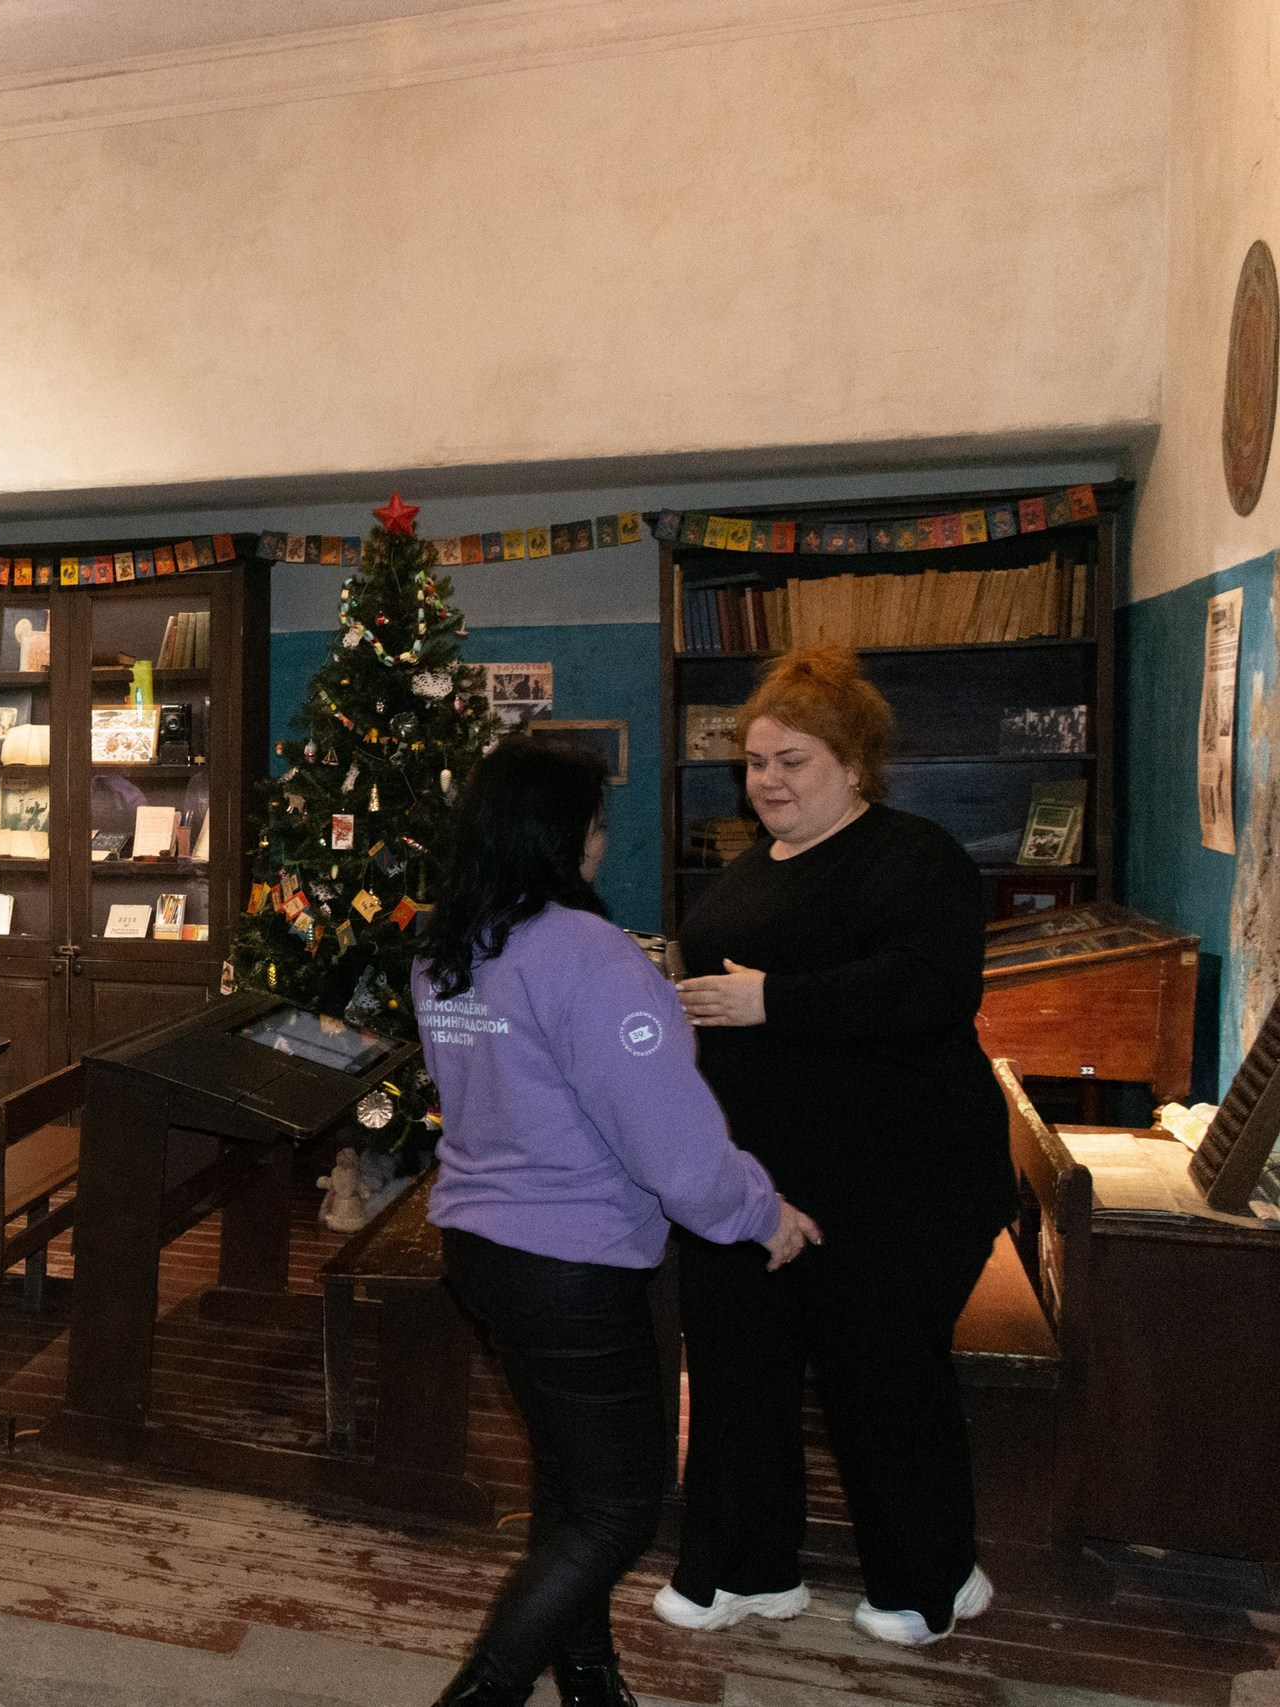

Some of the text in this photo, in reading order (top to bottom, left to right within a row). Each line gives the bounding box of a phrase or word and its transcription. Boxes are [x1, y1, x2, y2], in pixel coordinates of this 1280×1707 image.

[434, 999, 487, 1016] МОЛОДЁЖИ
[431, 1031, 474, 1046] ОБЛАСТИ
[632, 1030, 644, 1040] 39
[1080, 1066, 1095, 1075] 32
